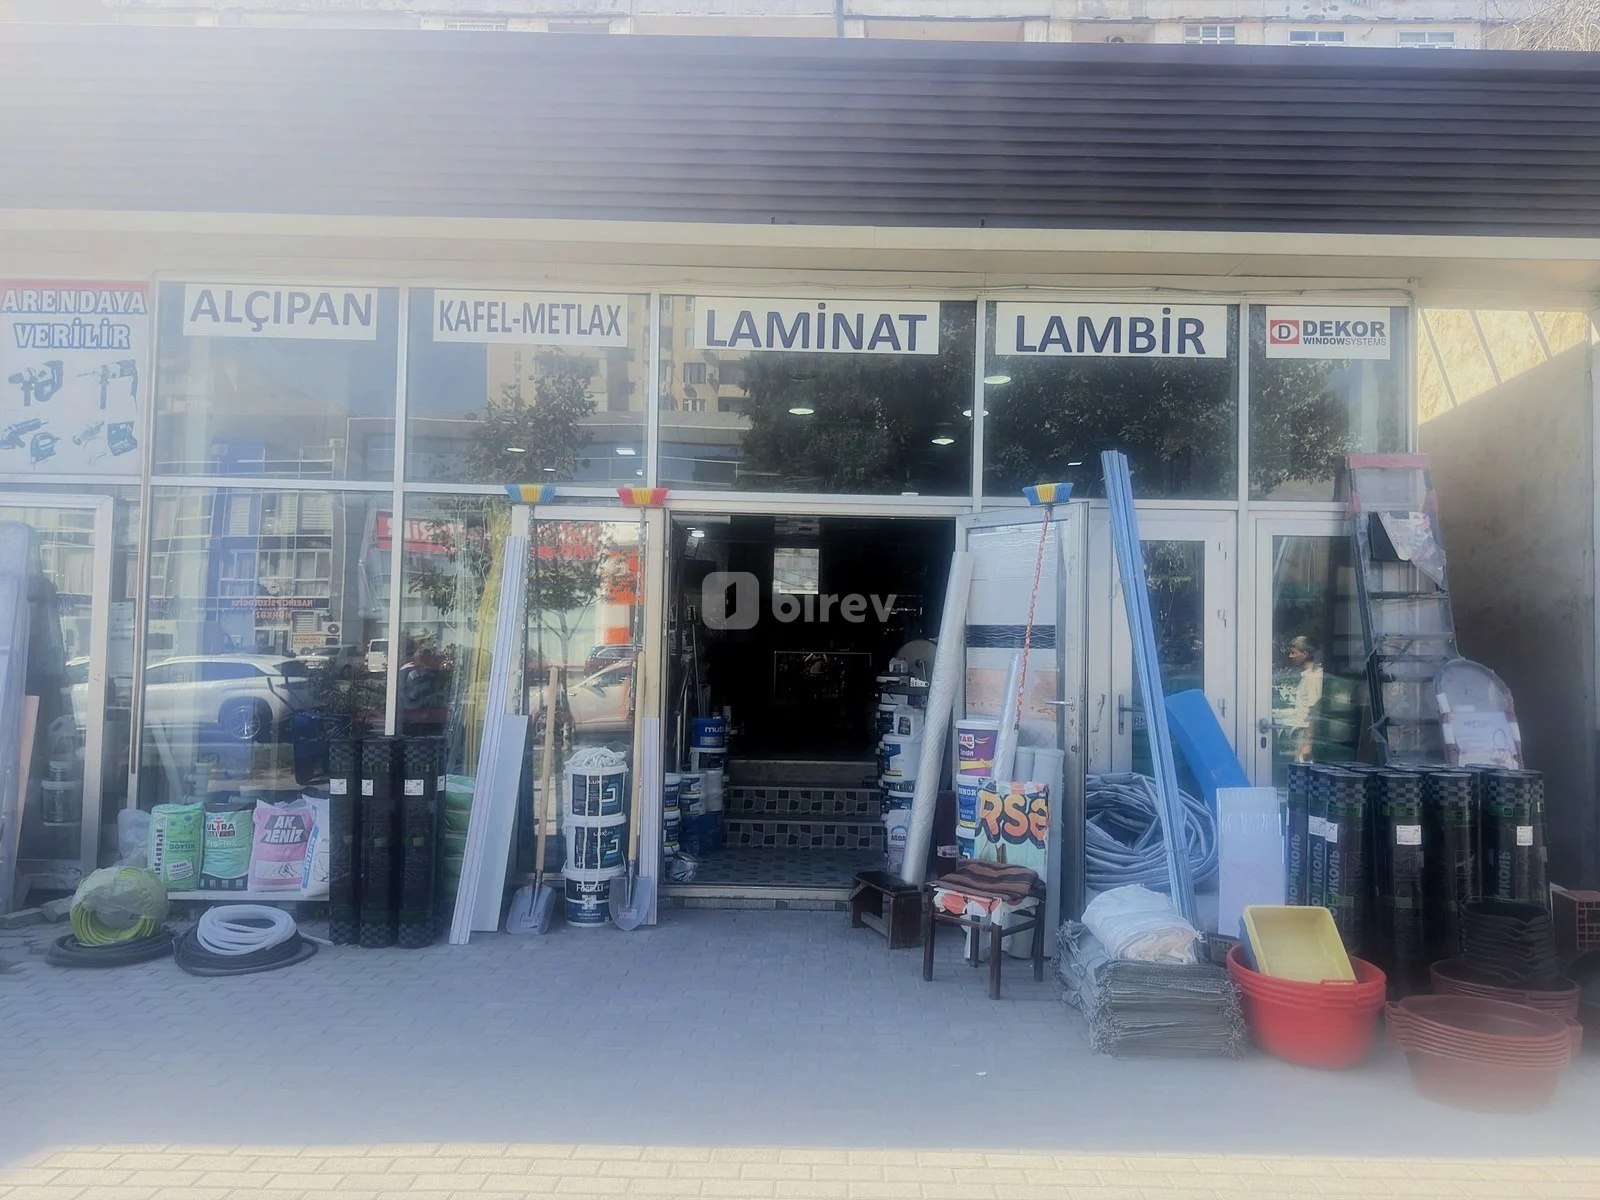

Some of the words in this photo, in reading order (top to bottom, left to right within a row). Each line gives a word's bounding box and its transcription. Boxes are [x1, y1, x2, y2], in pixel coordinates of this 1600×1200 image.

[1, 288, 148, 315] ARENDAYA
[189, 288, 373, 333] ALÇIPAN
[13, 316, 132, 350] VERİLİR
[439, 299, 622, 337] KAFEL-METLAX
[706, 302, 927, 351] LAMİNAT
[1016, 307, 1207, 355] LAMBİR
[1302, 320, 1387, 338] DEKOR
[206, 819, 235, 833] ULTRA
[263, 825, 304, 844] DENİZ
[273, 815, 296, 829] AK
